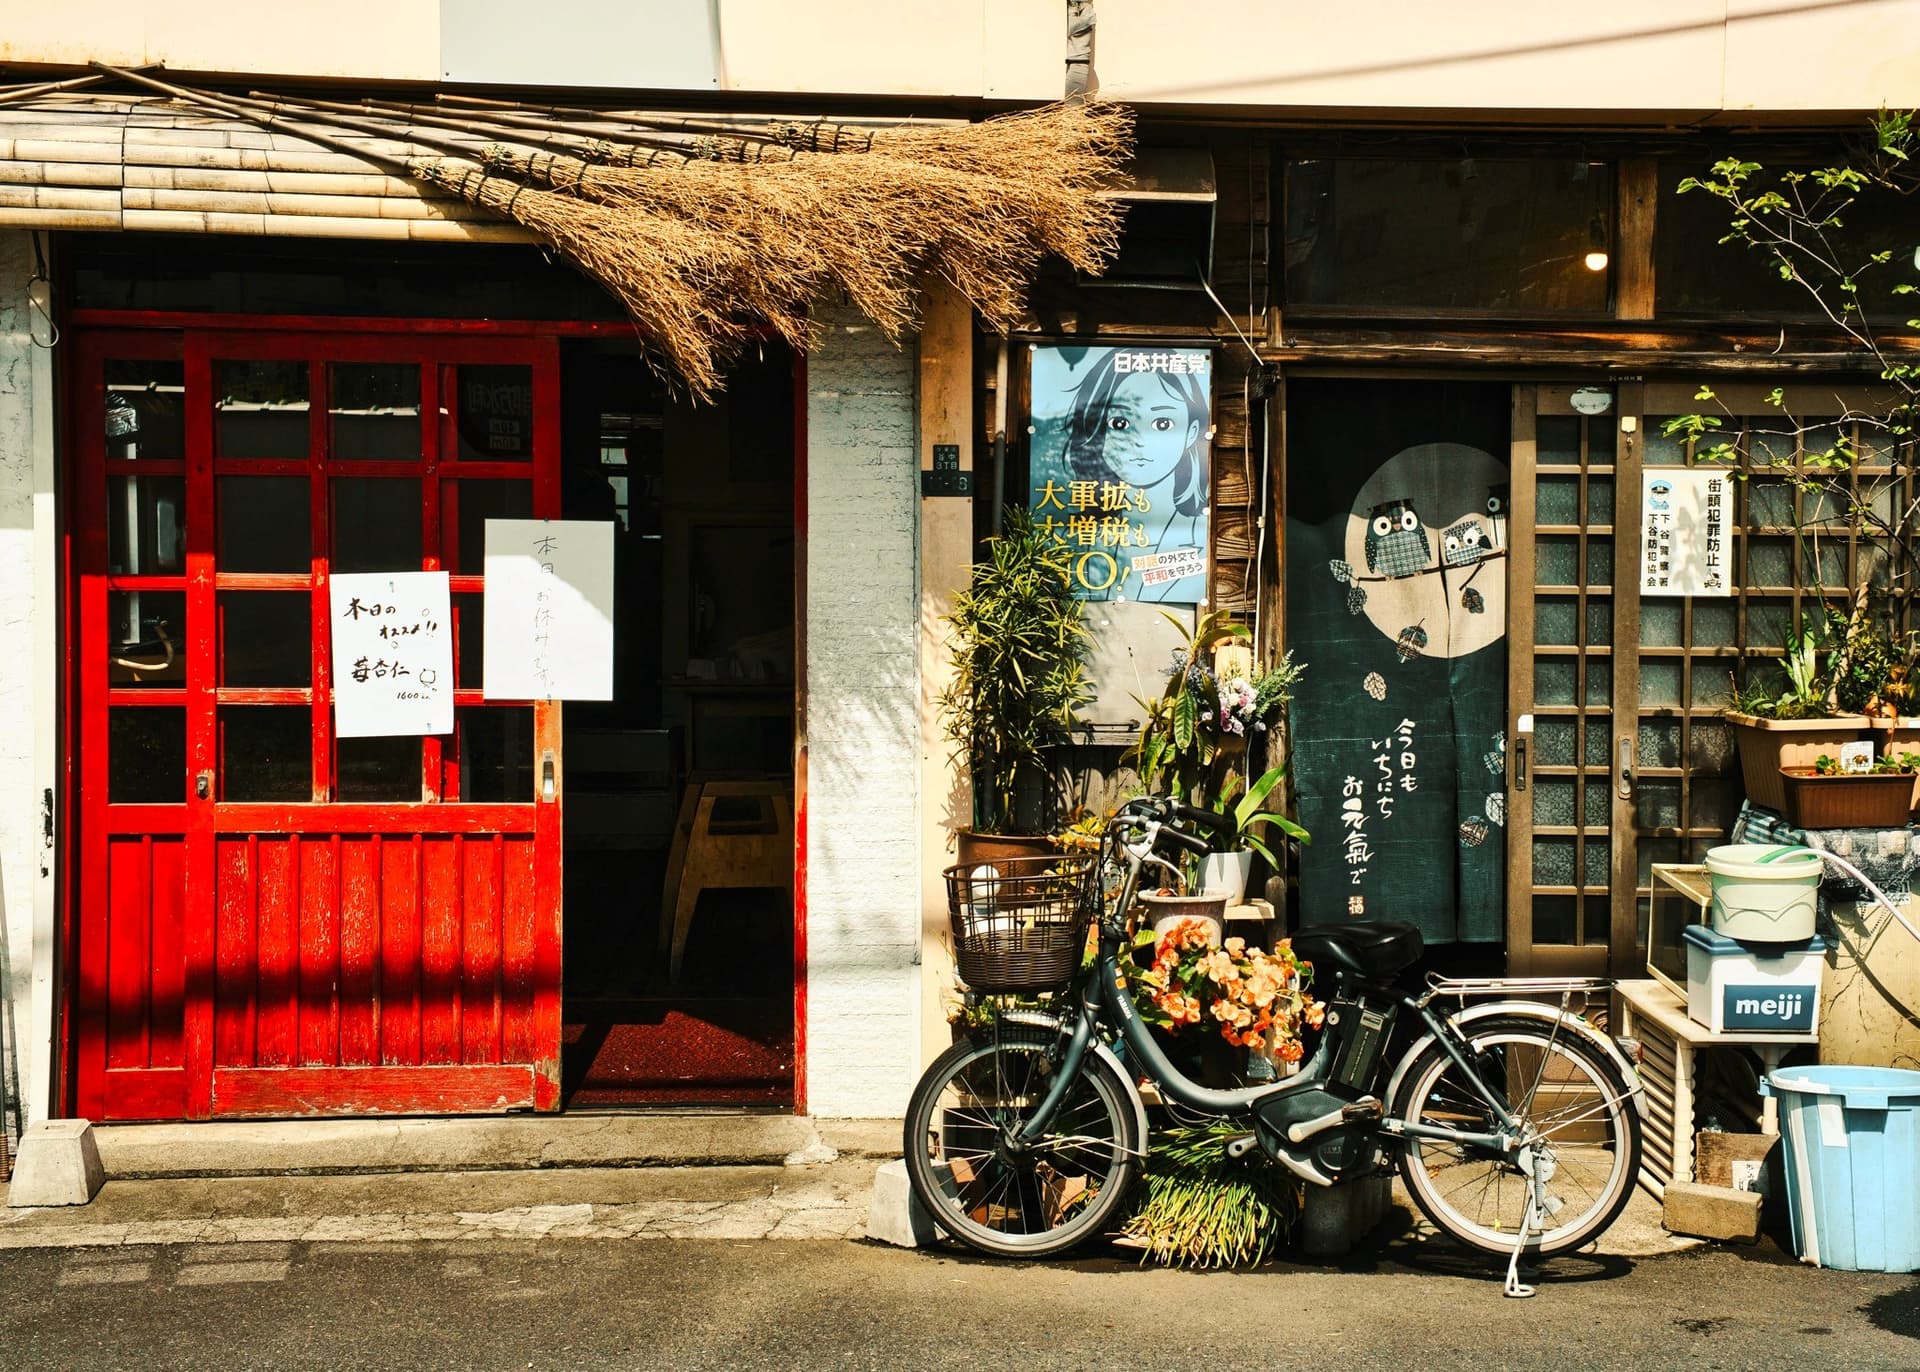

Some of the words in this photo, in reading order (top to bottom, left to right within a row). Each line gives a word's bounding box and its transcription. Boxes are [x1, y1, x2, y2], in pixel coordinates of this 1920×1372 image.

[1114, 352, 1206, 374] 日本共産党
[1035, 480, 1150, 512] 大軍拡も
[1034, 515, 1150, 548] 大増税も
[1706, 479, 1722, 567] 街頭犯罪防止
[1133, 551, 1197, 569] 対話の外交で
[1647, 513, 1658, 587] 下谷防犯協会
[1144, 562, 1203, 584] 平和を守ろう
[1394, 718, 1418, 792] 今日も
[1372, 737, 1394, 819] いちにち
[1736, 993, 1802, 1020] meiji
